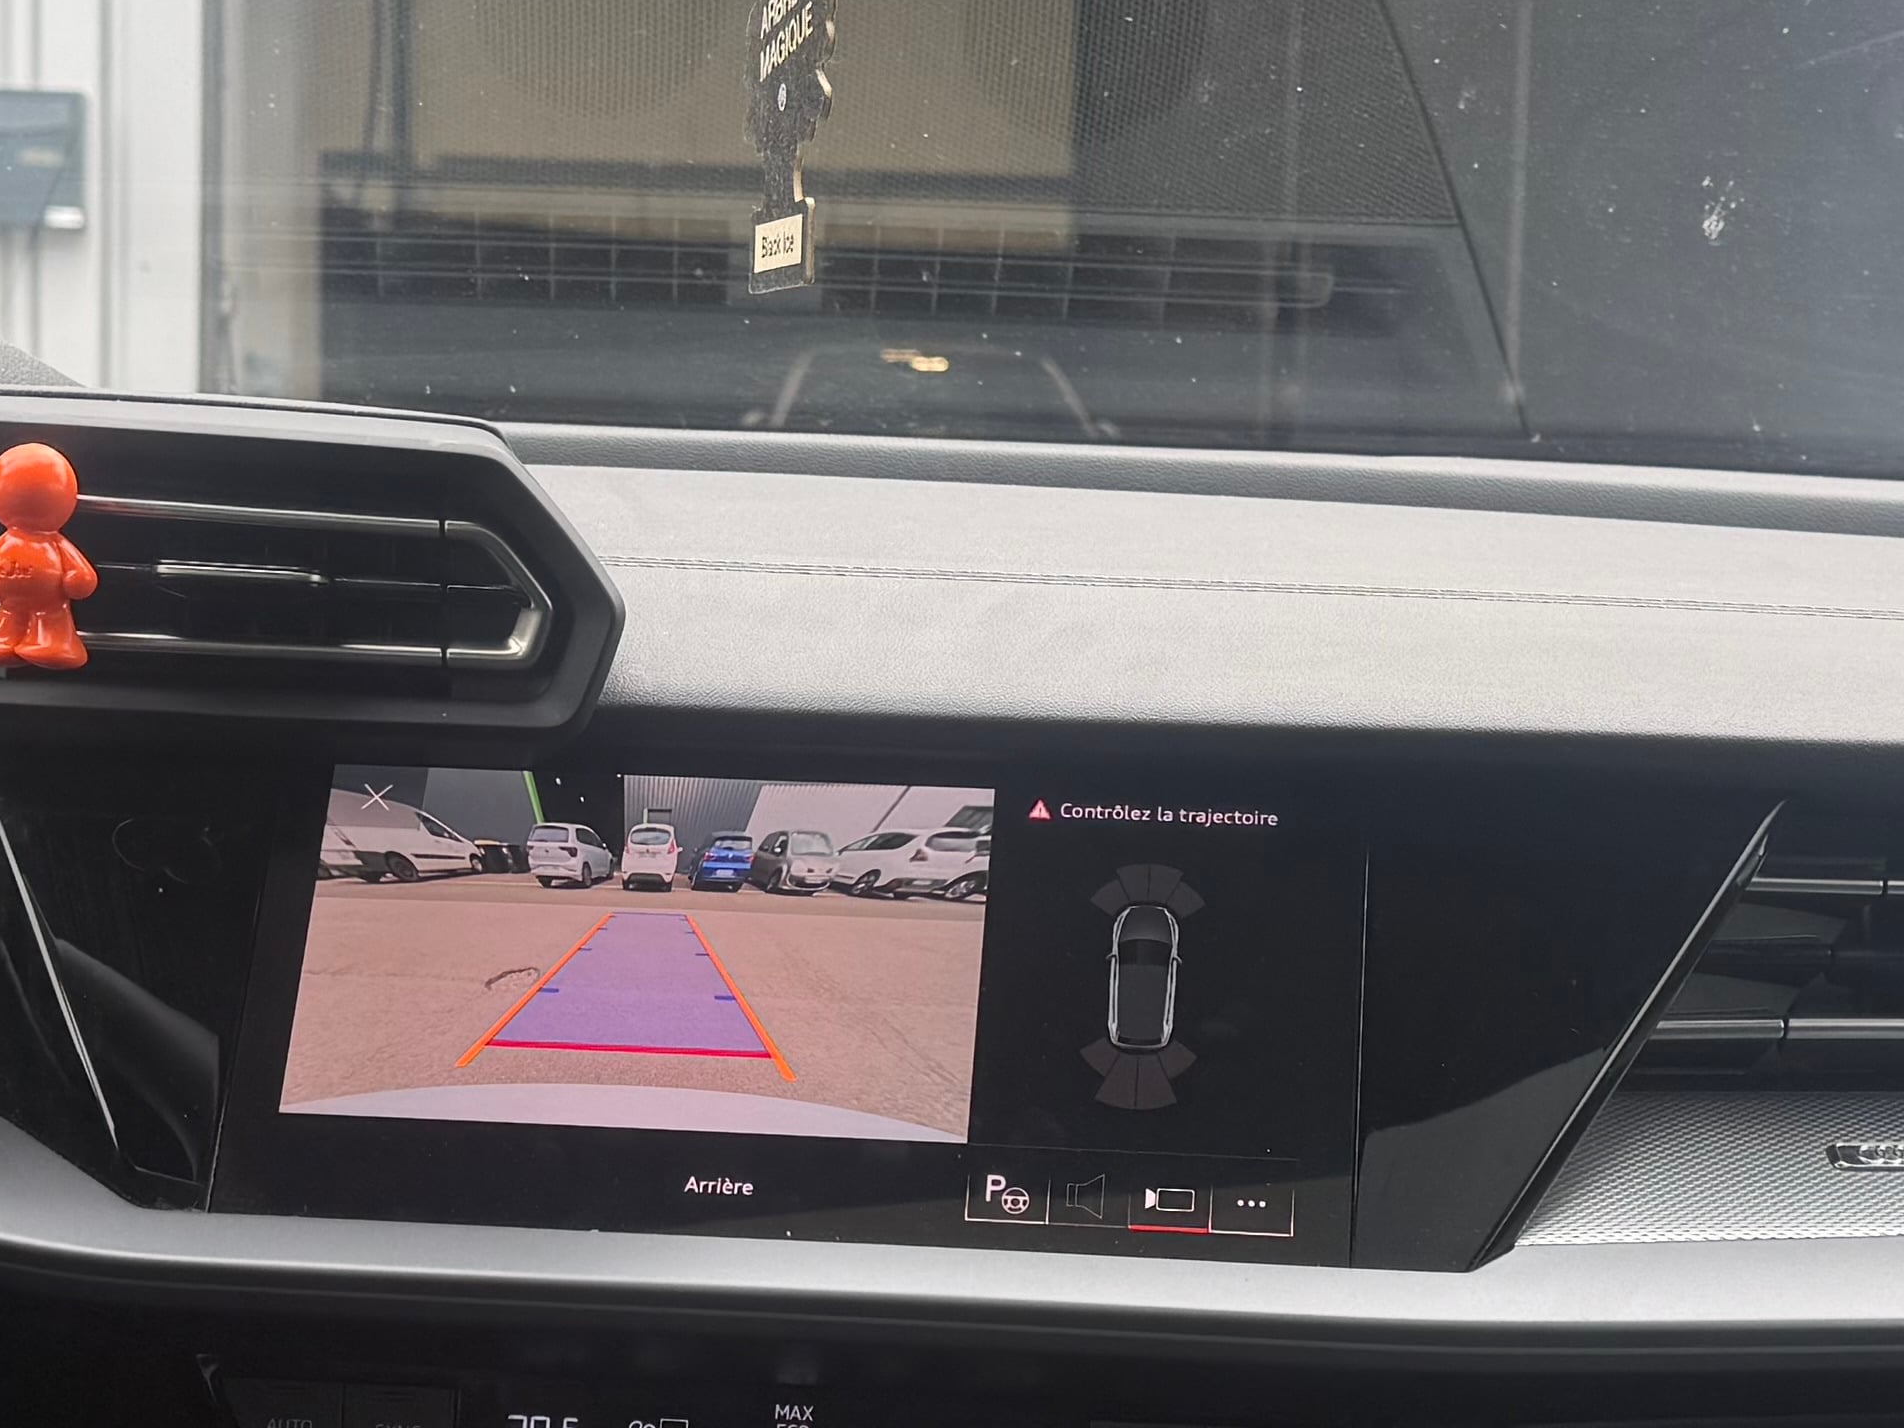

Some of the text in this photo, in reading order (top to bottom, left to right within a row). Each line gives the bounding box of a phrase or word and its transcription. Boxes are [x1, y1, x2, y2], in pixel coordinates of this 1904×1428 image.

[760, 1, 813, 82] MAGIQUE
[1060, 802, 1279, 828] Contrôlez la trajectoire
[684, 1174, 754, 1198] Arrière
[775, 1404, 814, 1421] MAX
